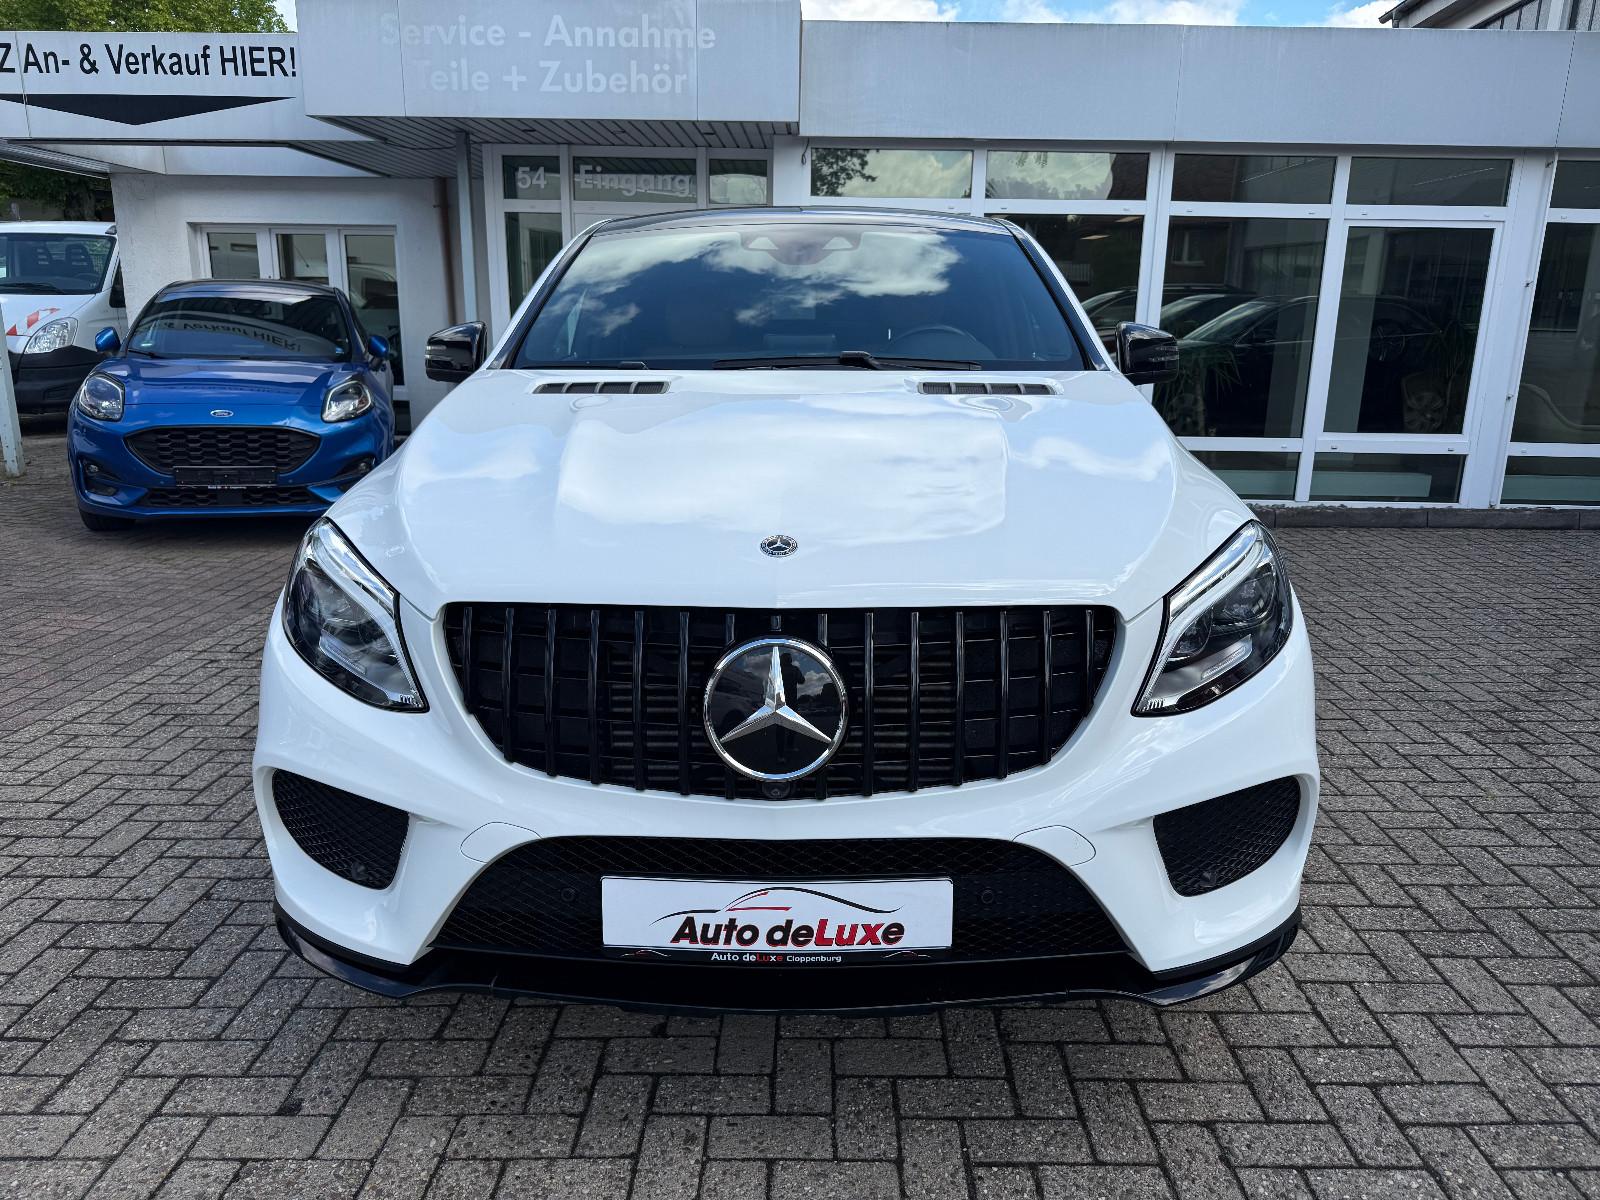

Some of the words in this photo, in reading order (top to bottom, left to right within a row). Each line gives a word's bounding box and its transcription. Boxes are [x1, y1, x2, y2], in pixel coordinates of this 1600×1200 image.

[380, 12, 506, 46] Service
[544, 14, 716, 48] Annahme
[24, 43, 70, 74] An-
[79, 43, 99, 74] &
[105, 44, 210, 75] Verkauf
[219, 46, 297, 77] HIER!
[412, 58, 490, 92] Teile
[539, 60, 687, 93] Zubehör
[517, 166, 547, 189] 54
[579, 165, 693, 196] Eingang
[670, 916, 760, 947] Auto
[766, 919, 905, 947] deLuxe
[711, 952, 740, 962] Auto
[742, 953, 783, 963] deLuxe
[786, 955, 842, 964] Cloppenburg
